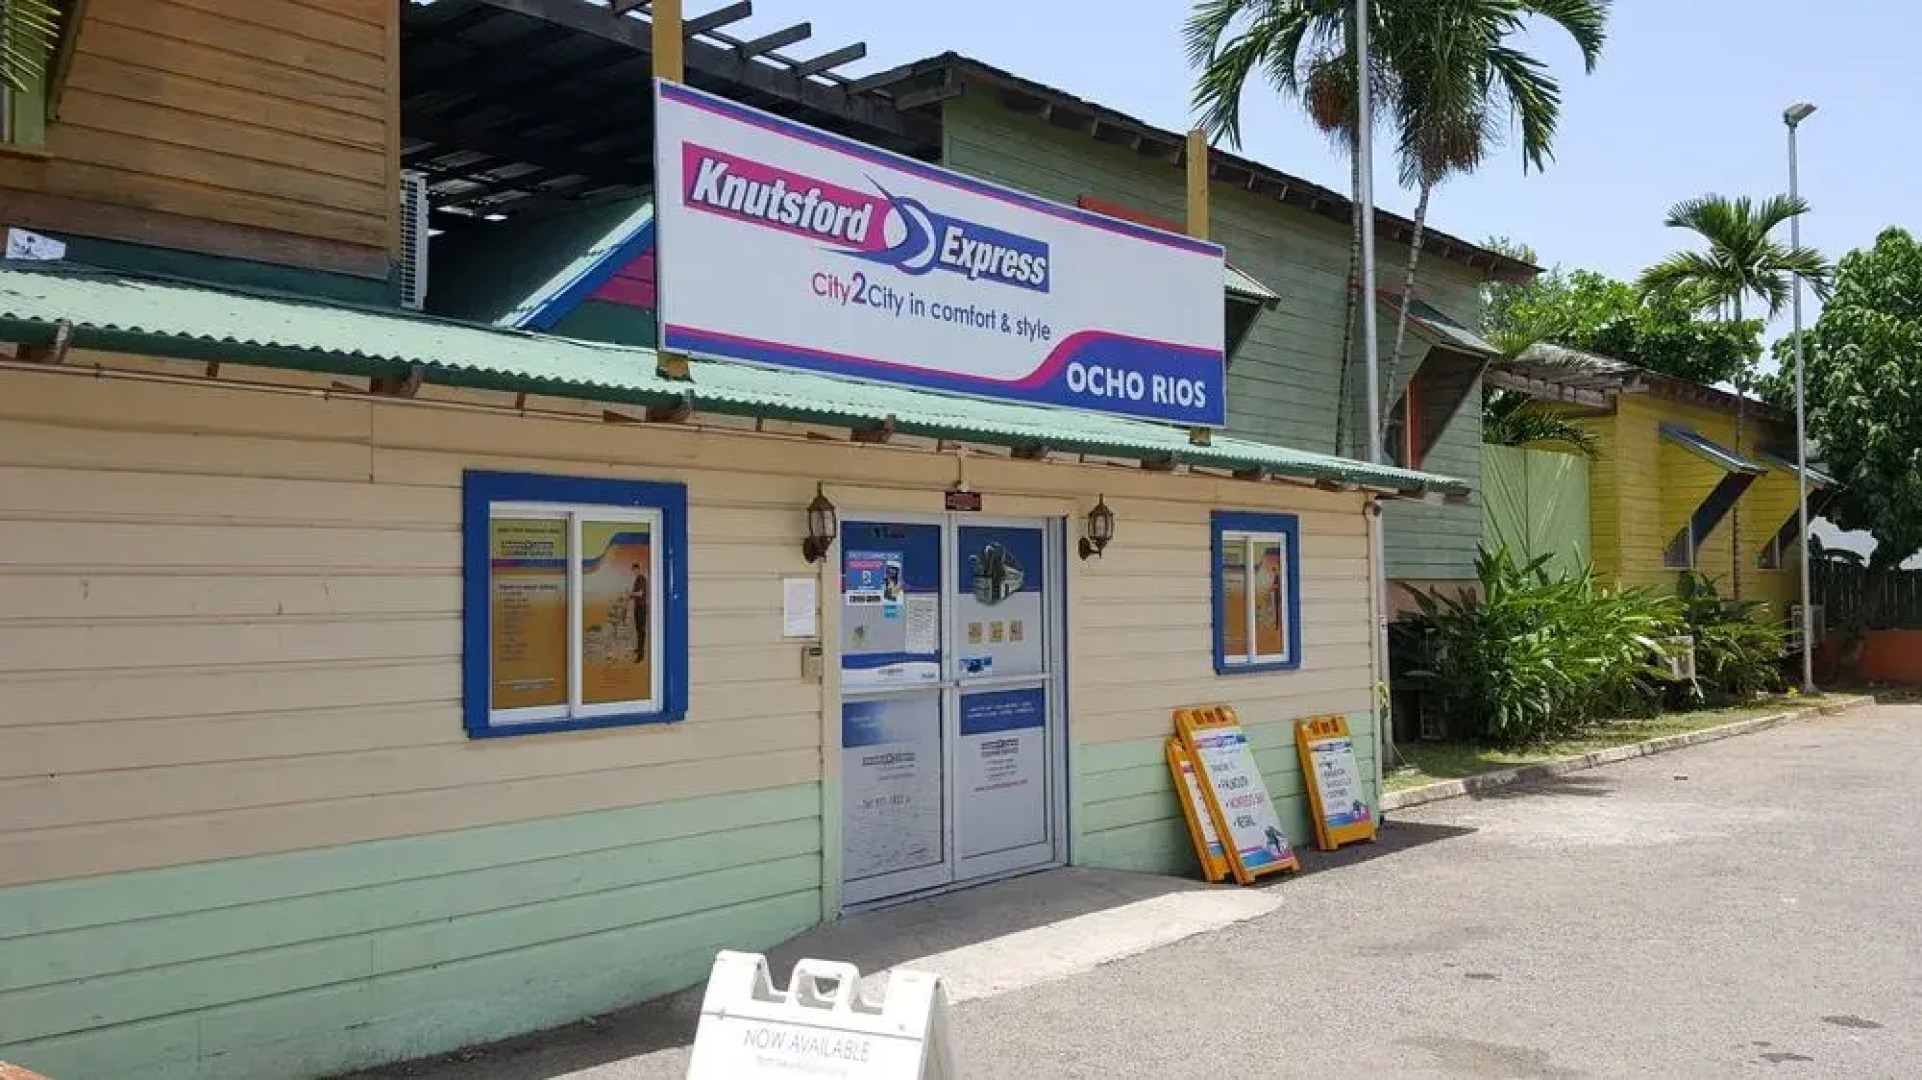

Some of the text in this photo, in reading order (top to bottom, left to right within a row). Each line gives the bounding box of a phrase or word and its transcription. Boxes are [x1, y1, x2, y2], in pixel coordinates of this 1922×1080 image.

[692, 156, 1047, 286] Knutsford Express
[909, 291, 925, 317] in
[931, 301, 996, 330] comfort
[1000, 313, 1012, 333] &
[1016, 316, 1051, 343] style
[1066, 361, 1207, 409] OCHO RIOS
[743, 1028, 871, 1063] NOW AVAILABLE
